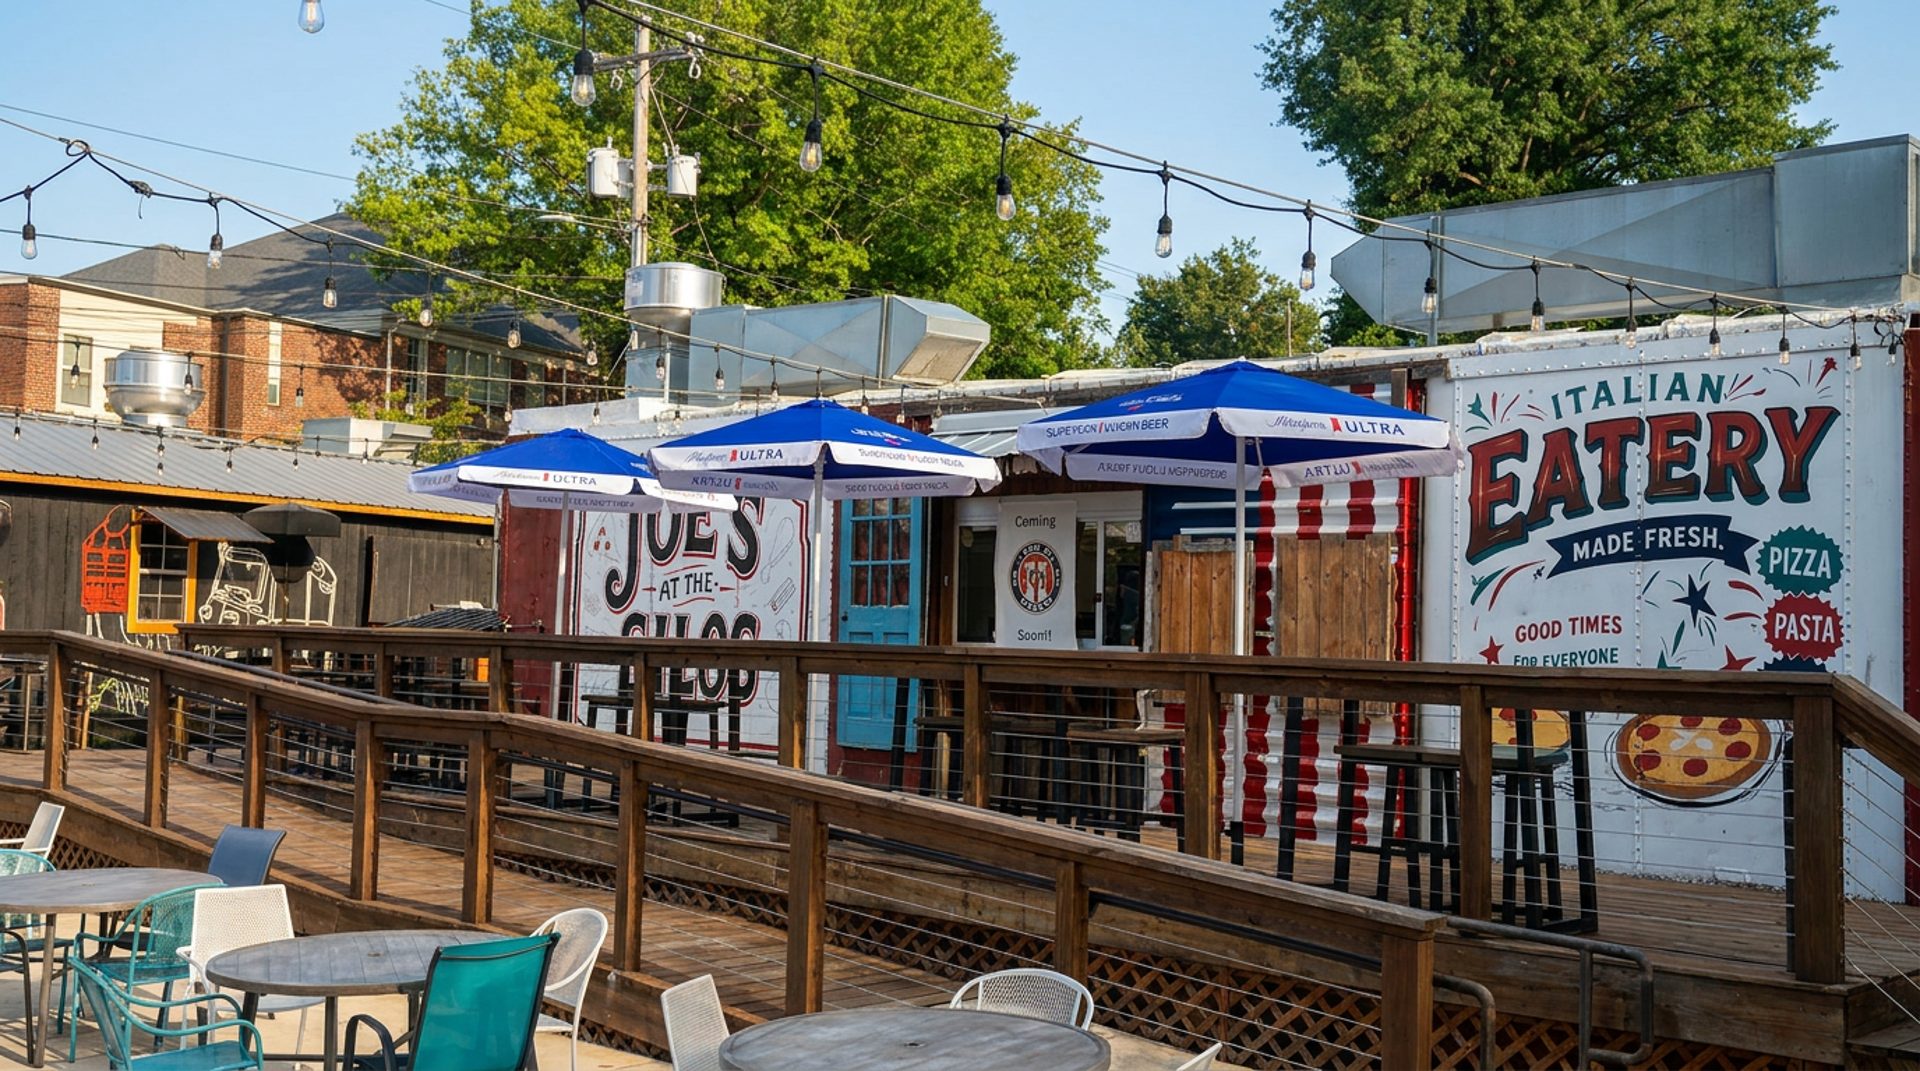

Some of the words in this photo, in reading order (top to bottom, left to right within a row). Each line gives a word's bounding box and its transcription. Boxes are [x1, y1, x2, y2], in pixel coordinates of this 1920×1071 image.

[1551, 372, 1725, 420] ITALIAN
[1344, 420, 1405, 436] ULTRA
[740, 448, 783, 461] ULTRA
[1465, 406, 1841, 566] EATERY
[1573, 531, 1634, 562] MADE
[1645, 526, 1724, 551] FRESH.
[1769, 546, 1832, 579] PIZZA
[659, 577, 680, 601] AT
[684, 572, 714, 595] THE
[1515, 620, 1562, 643] GOOD
[1568, 615, 1623, 636] TIMES
[1774, 612, 1835, 643] PASTA
[1542, 648, 1619, 667] EVERYONE
